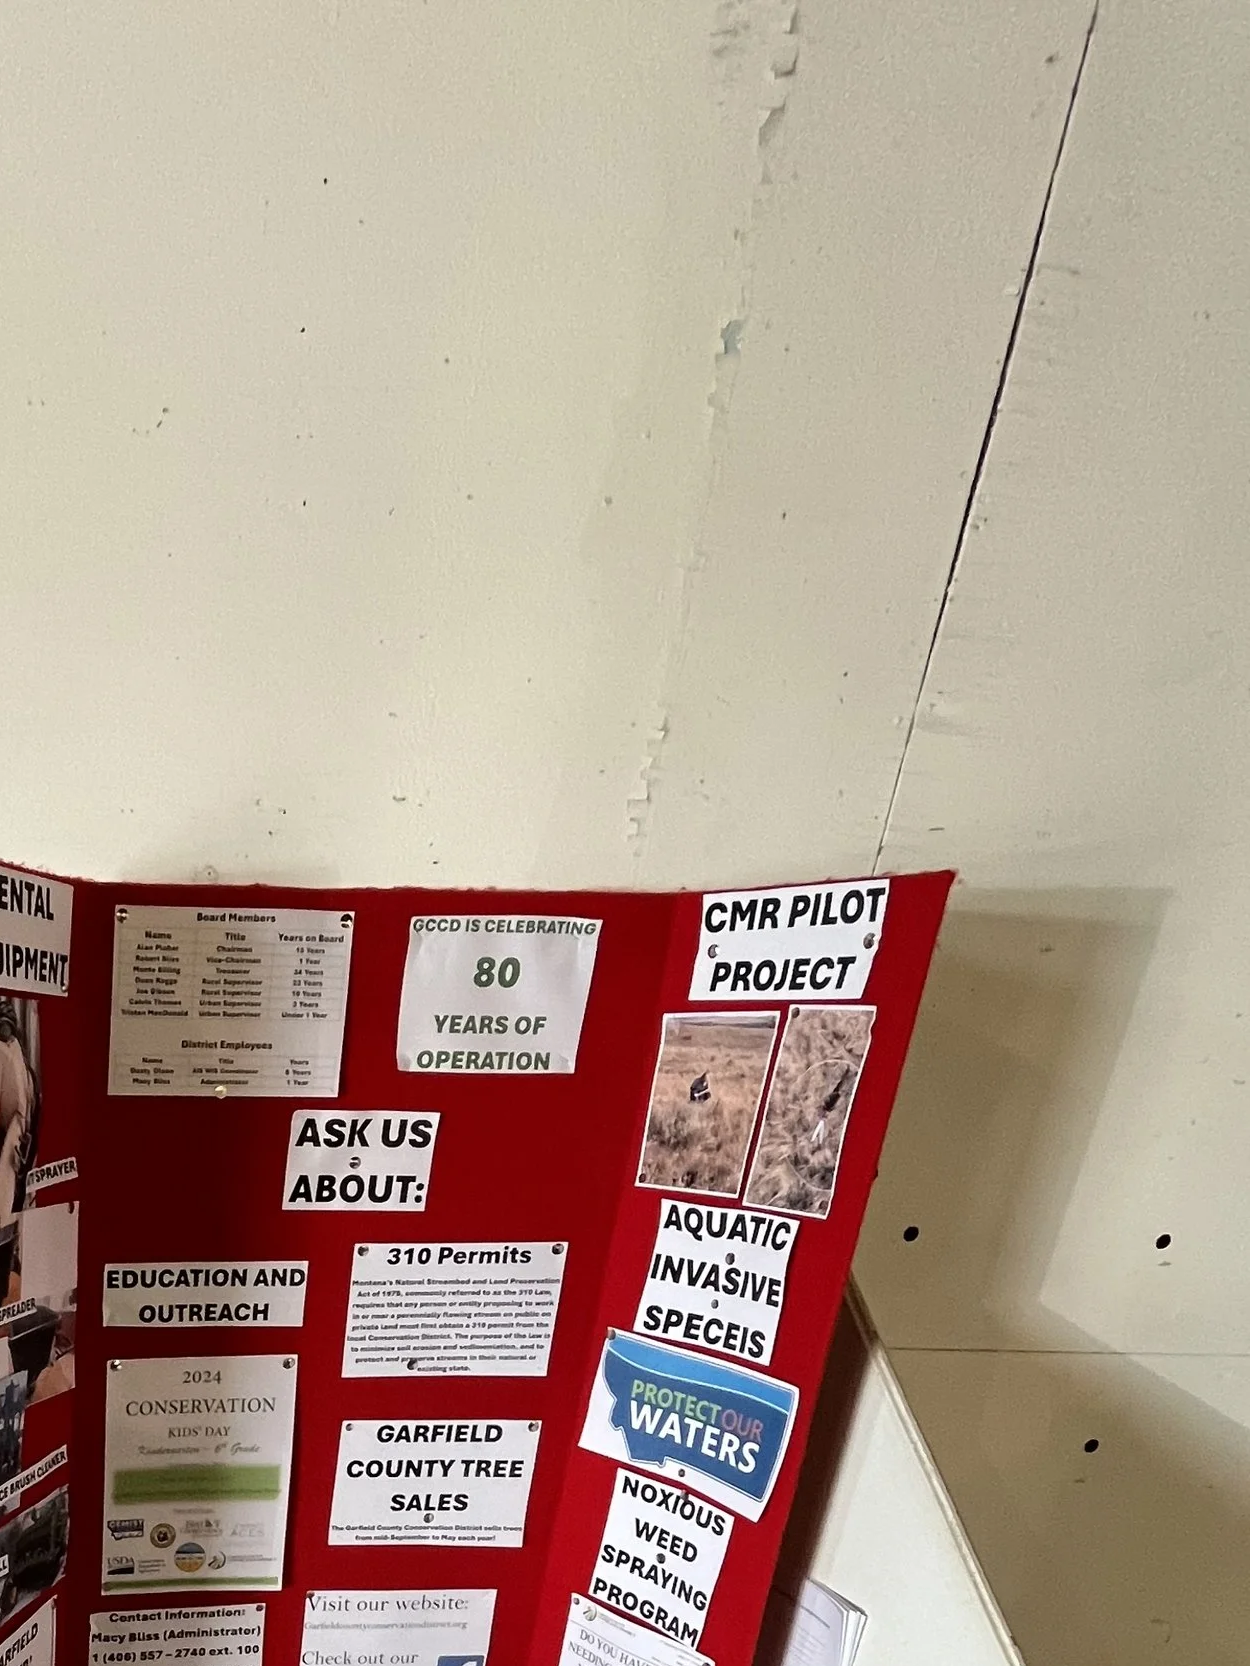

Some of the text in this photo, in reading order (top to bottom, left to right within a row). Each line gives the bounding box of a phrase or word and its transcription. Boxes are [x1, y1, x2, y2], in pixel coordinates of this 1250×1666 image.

[705, 887, 886, 933] CMR PILOT
[413, 919, 596, 935] GCCD IS CELEBRATING
[473, 957, 521, 988] 80
[709, 956, 857, 992] PROJECT
[434, 1015, 547, 1035] YEARS OF
[417, 1050, 550, 1070] OPERATION
[295, 1118, 433, 1148] ASK US
[288, 1175, 425, 1203] ABOUT:
[663, 1204, 792, 1251] AQUATIC
[387, 1246, 532, 1265] 310 Permits
[106, 1268, 306, 1289] EDUCATION AND
[650, 1253, 782, 1308] INVASIVE
[139, 1303, 269, 1323] OUTREACH
[643, 1305, 766, 1358] SPECEIS
[182, 1371, 222, 1384] 2024
[126, 1397, 276, 1416] CONSERVATION
[632, 1379, 763, 1443] PROTECT OUR
[377, 1424, 503, 1443] GARFIELD
[630, 1399, 760, 1474] WATERS
[346, 1460, 524, 1478] COUNTY TREE
[390, 1494, 469, 1511] SALES
[622, 1475, 726, 1536] NOXIOUS
[635, 1518, 698, 1563] WEED
[601, 1544, 707, 1611] SPRAYING
[308, 1594, 469, 1612] Visit our website:
[592, 1577, 699, 1646] PROGRAM
[109, 1609, 245, 1623] Contact Information:
[91, 1625, 261, 1644] Macy Bliss (Administrator)
